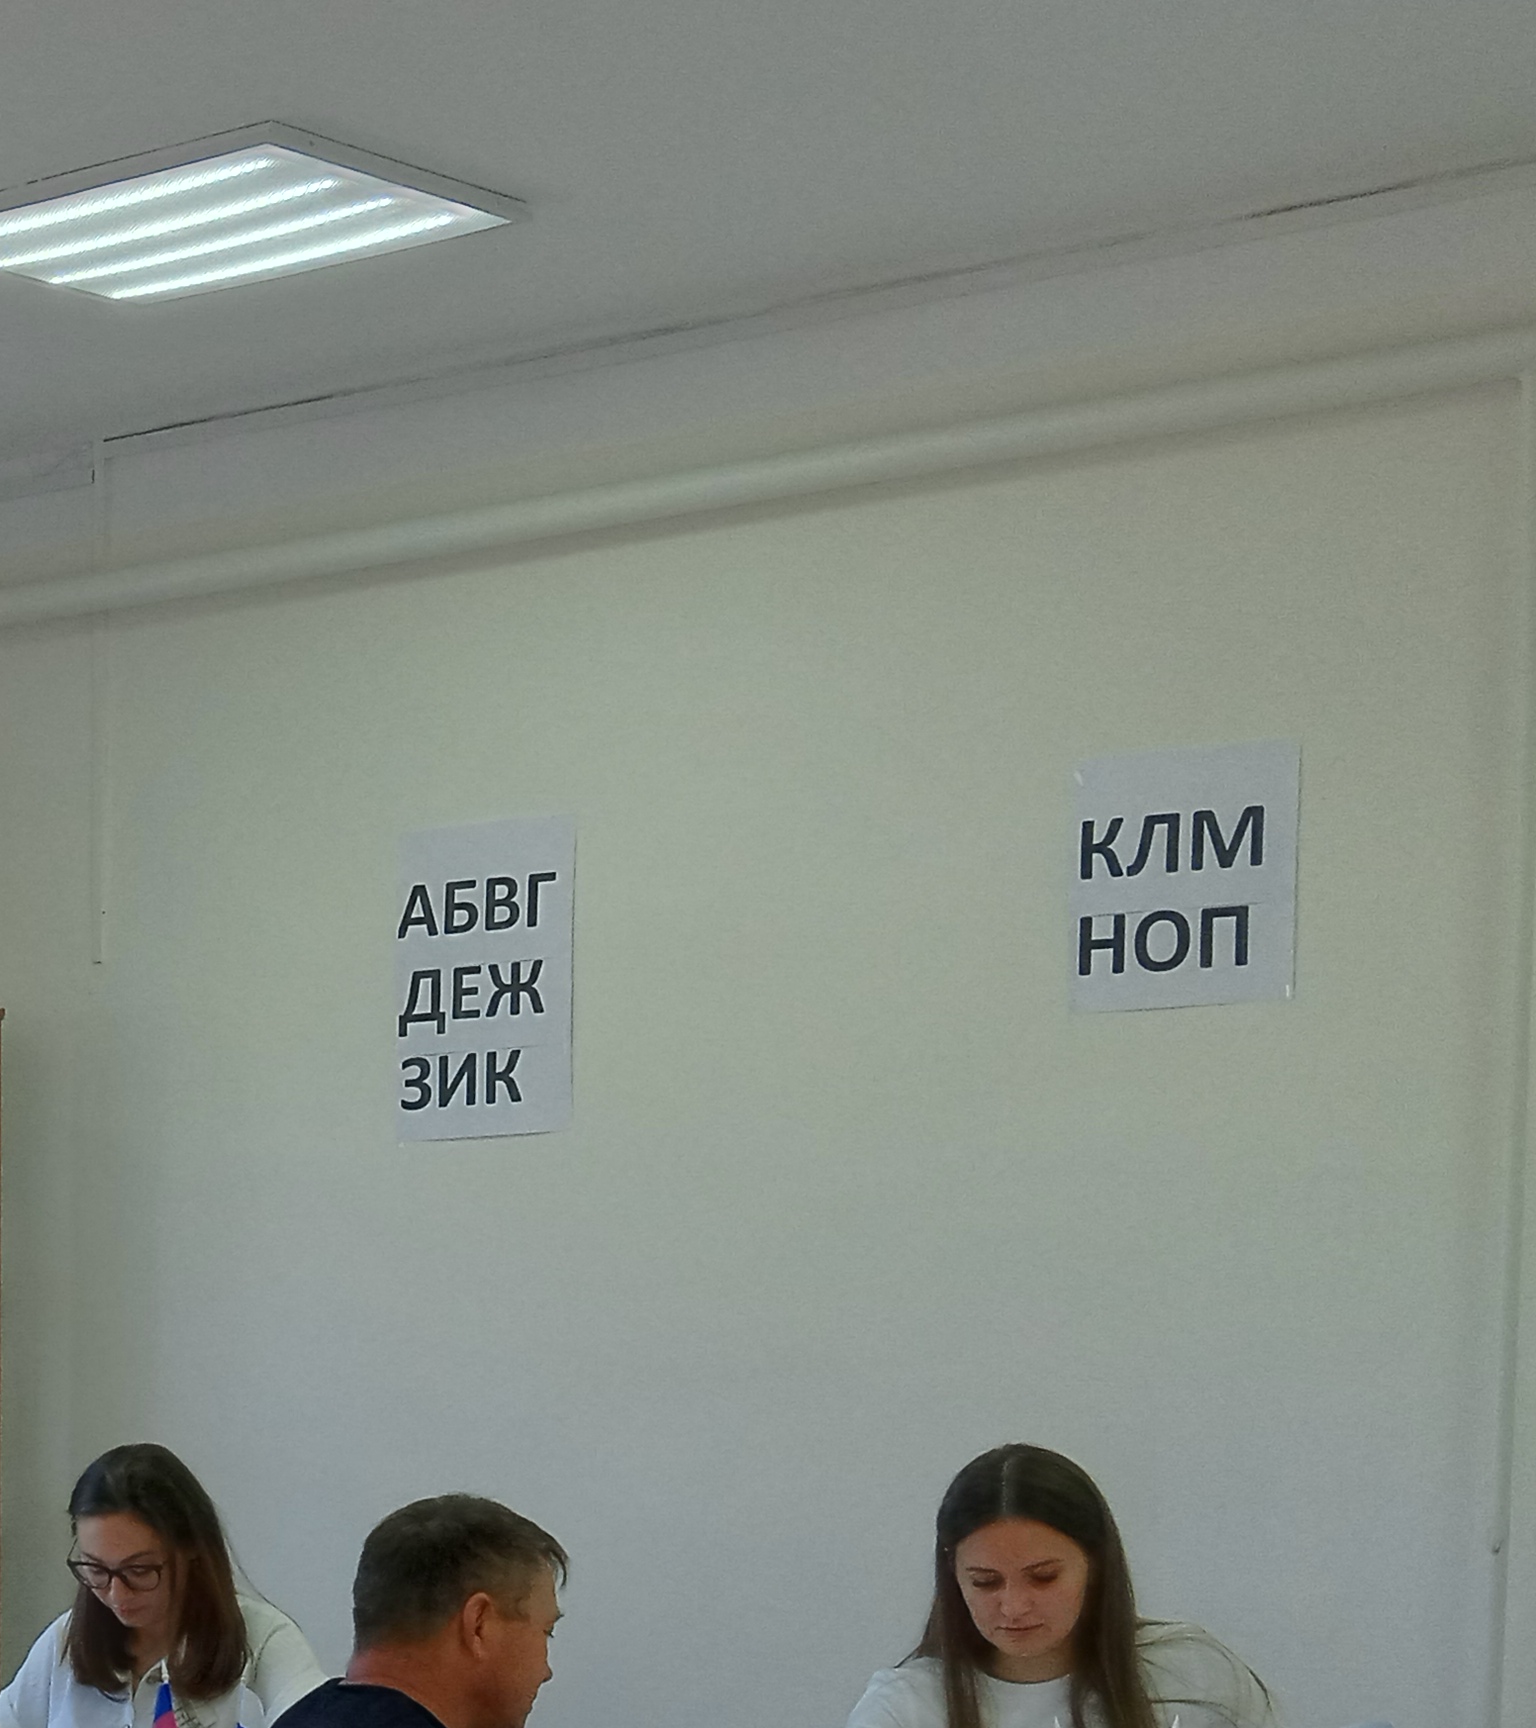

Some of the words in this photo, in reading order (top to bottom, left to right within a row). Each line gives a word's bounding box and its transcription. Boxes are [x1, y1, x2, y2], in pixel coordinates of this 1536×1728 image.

[1080, 805, 1265, 880] КЛМ
[397, 871, 557, 939] АБВГ
[1078, 905, 1250, 976] НОП
[397, 959, 545, 1037] ДЕЖ
[400, 1049, 522, 1111] ЗИК
